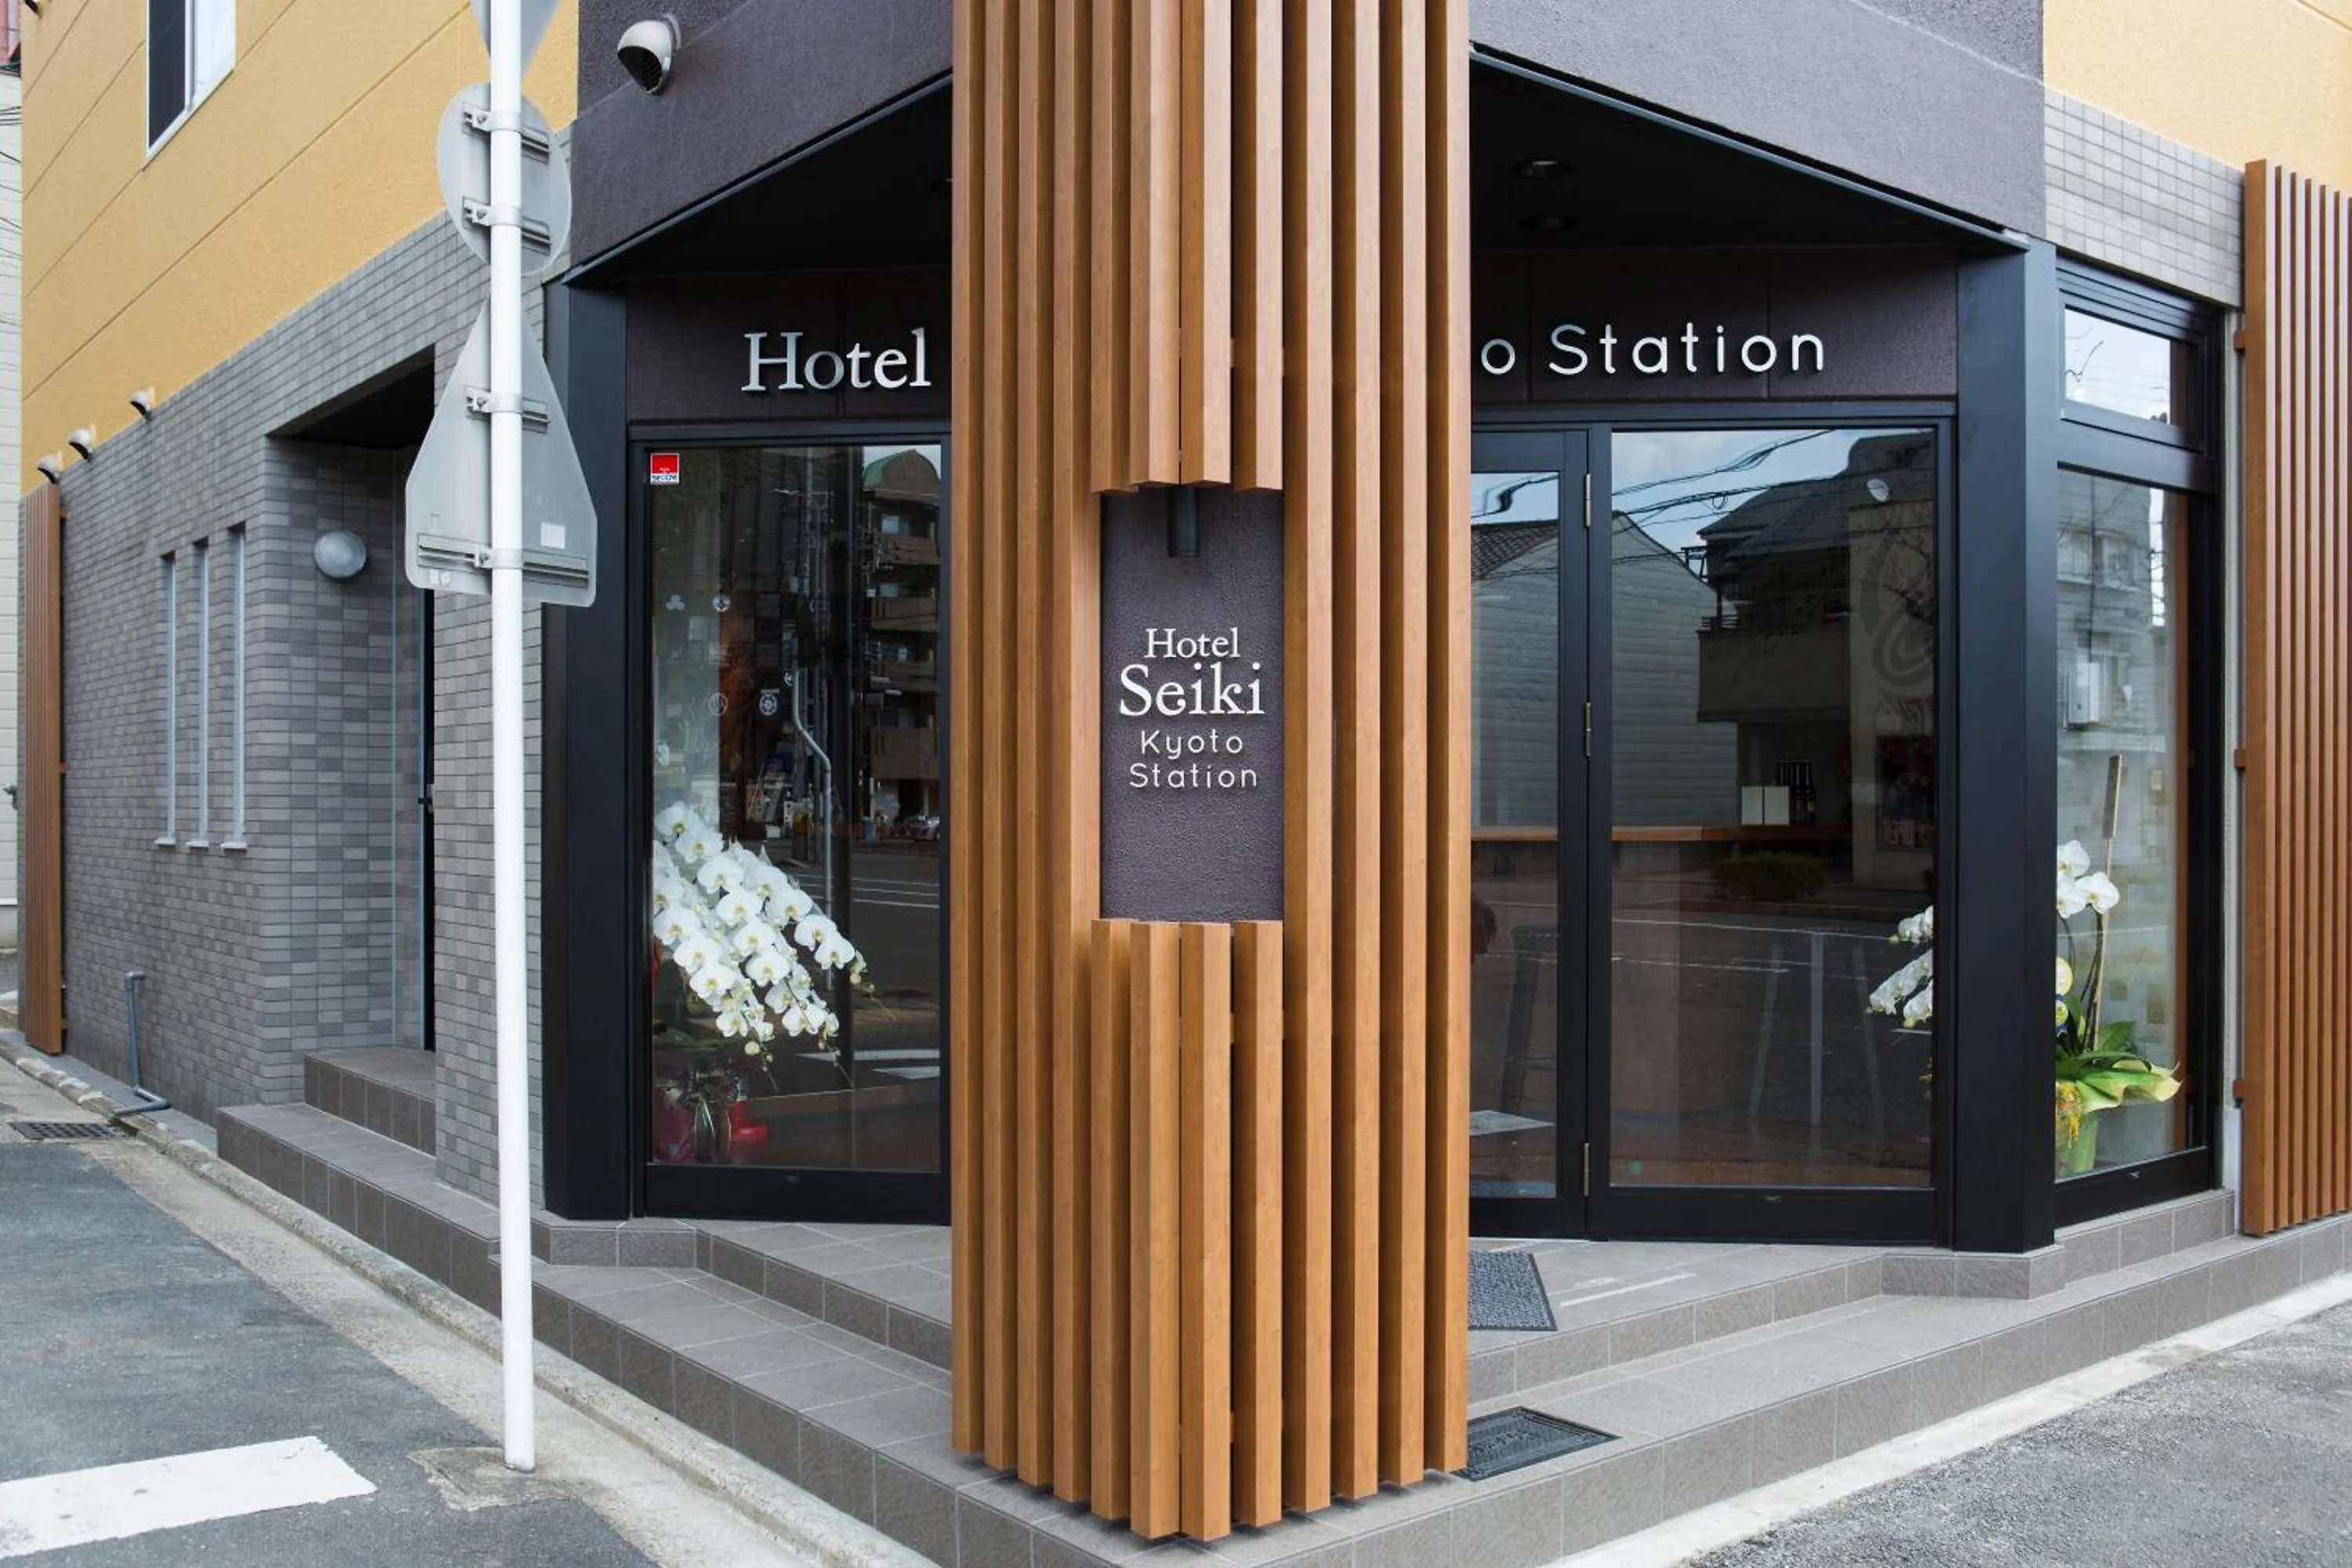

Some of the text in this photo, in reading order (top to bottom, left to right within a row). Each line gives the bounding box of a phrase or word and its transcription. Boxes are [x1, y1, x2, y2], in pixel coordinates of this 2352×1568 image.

[741, 328, 931, 391] Hotel
[1548, 321, 1824, 376] Station
[1144, 626, 1241, 659] Hotel
[1119, 661, 1265, 717] Seiki
[1141, 728, 1243, 760] Kyoto
[1129, 762, 1258, 789] Station
